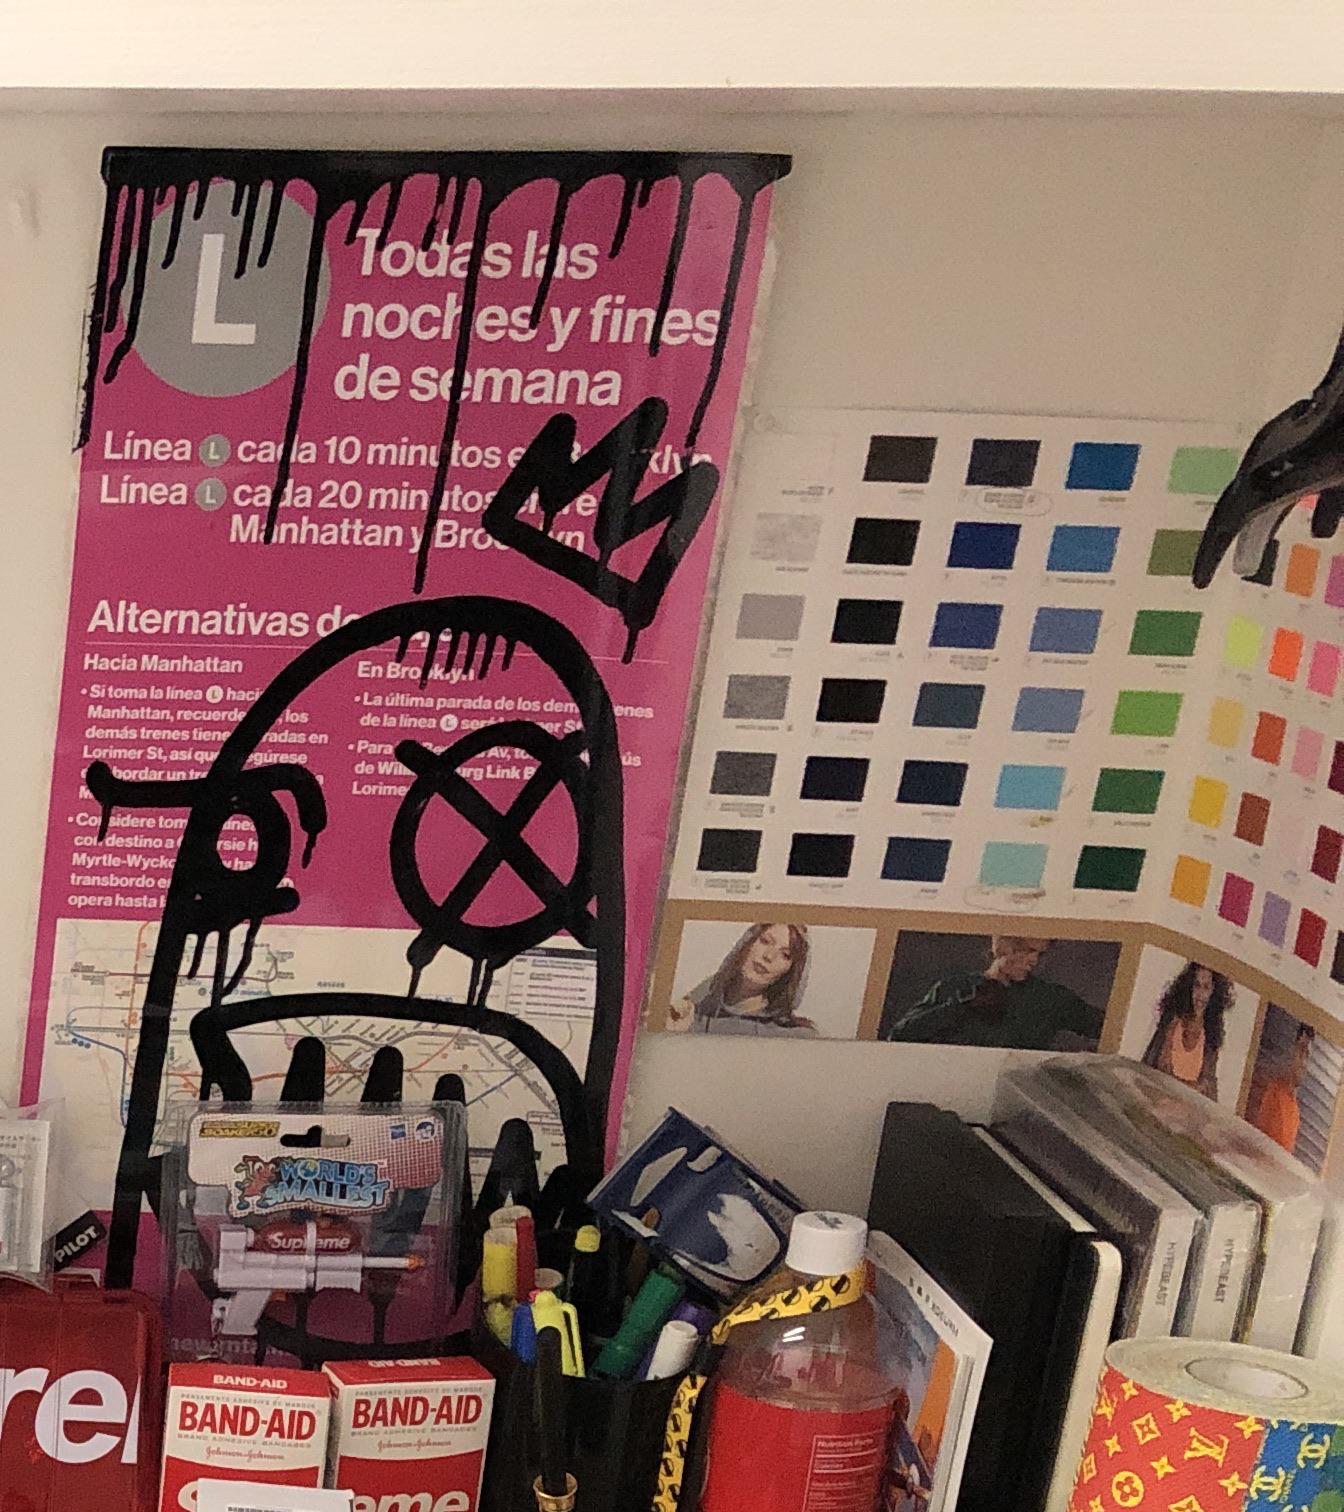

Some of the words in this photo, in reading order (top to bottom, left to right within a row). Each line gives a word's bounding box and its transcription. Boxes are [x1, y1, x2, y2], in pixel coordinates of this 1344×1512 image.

[356, 227, 513, 279] Todas
[522, 230, 599, 279] las
[192, 234, 256, 345] L
[341, 293, 538, 342] noches
[546, 307, 580, 352] y
[590, 295, 721, 346] fines
[334, 353, 400, 401] de
[409, 365, 622, 406] semana
[103, 431, 191, 460] Línea
[237, 434, 316, 464] cada
[324, 436, 361, 464] 10
[367, 437, 502, 468] minutos
[100, 475, 187, 505] Línea
[233, 479, 312, 507] cada
[319, 480, 362, 509] 20
[87, 600, 309, 637] Alternativas
[83, 654, 137, 671] Hacia
[141, 655, 243, 673] Manhattan
[357, 661, 384, 678] En
[89, 684, 105, 699] Si
[108, 686, 147, 699] toma
[150, 686, 163, 700] la
[166, 686, 202, 700] línea
[363, 693, 382, 706] La
[385, 693, 433, 709] última
[436, 698, 491, 711] parada
[494, 696, 514, 710] de
[517, 697, 540, 712] los
[88, 705, 174, 721] Manhattan,
[286, 710, 309, 723] los
[360, 714, 380, 727] de
[382, 714, 397, 727] la
[85, 726, 137, 739] demás
[140, 728, 189, 741] trenes
[309, 734, 328, 744] en
[83, 745, 143, 760] Lorimer
[147, 747, 167, 762] St,
[170, 747, 193, 761] así
[357, 741, 393, 754] Para
[167, 770, 186, 780] un
[355, 762, 374, 774] de
[487, 766, 519, 779] Link
[106, 835, 162, 848] destino
[165, 839, 174, 848] a
[70, 874, 154, 888] transbordo
[68, 895, 112, 907] opera
[115, 894, 157, 908] hasta
[280, 1158, 377, 1184] WORLD'S
[265, 1180, 390, 1207] SMALLEST
[55, 1225, 99, 1263] PILOT
[213, 1374, 288, 1390] BAND-AID
[179, 1401, 317, 1441] BAND-AID
[352, 1394, 483, 1429] BAND-AID
